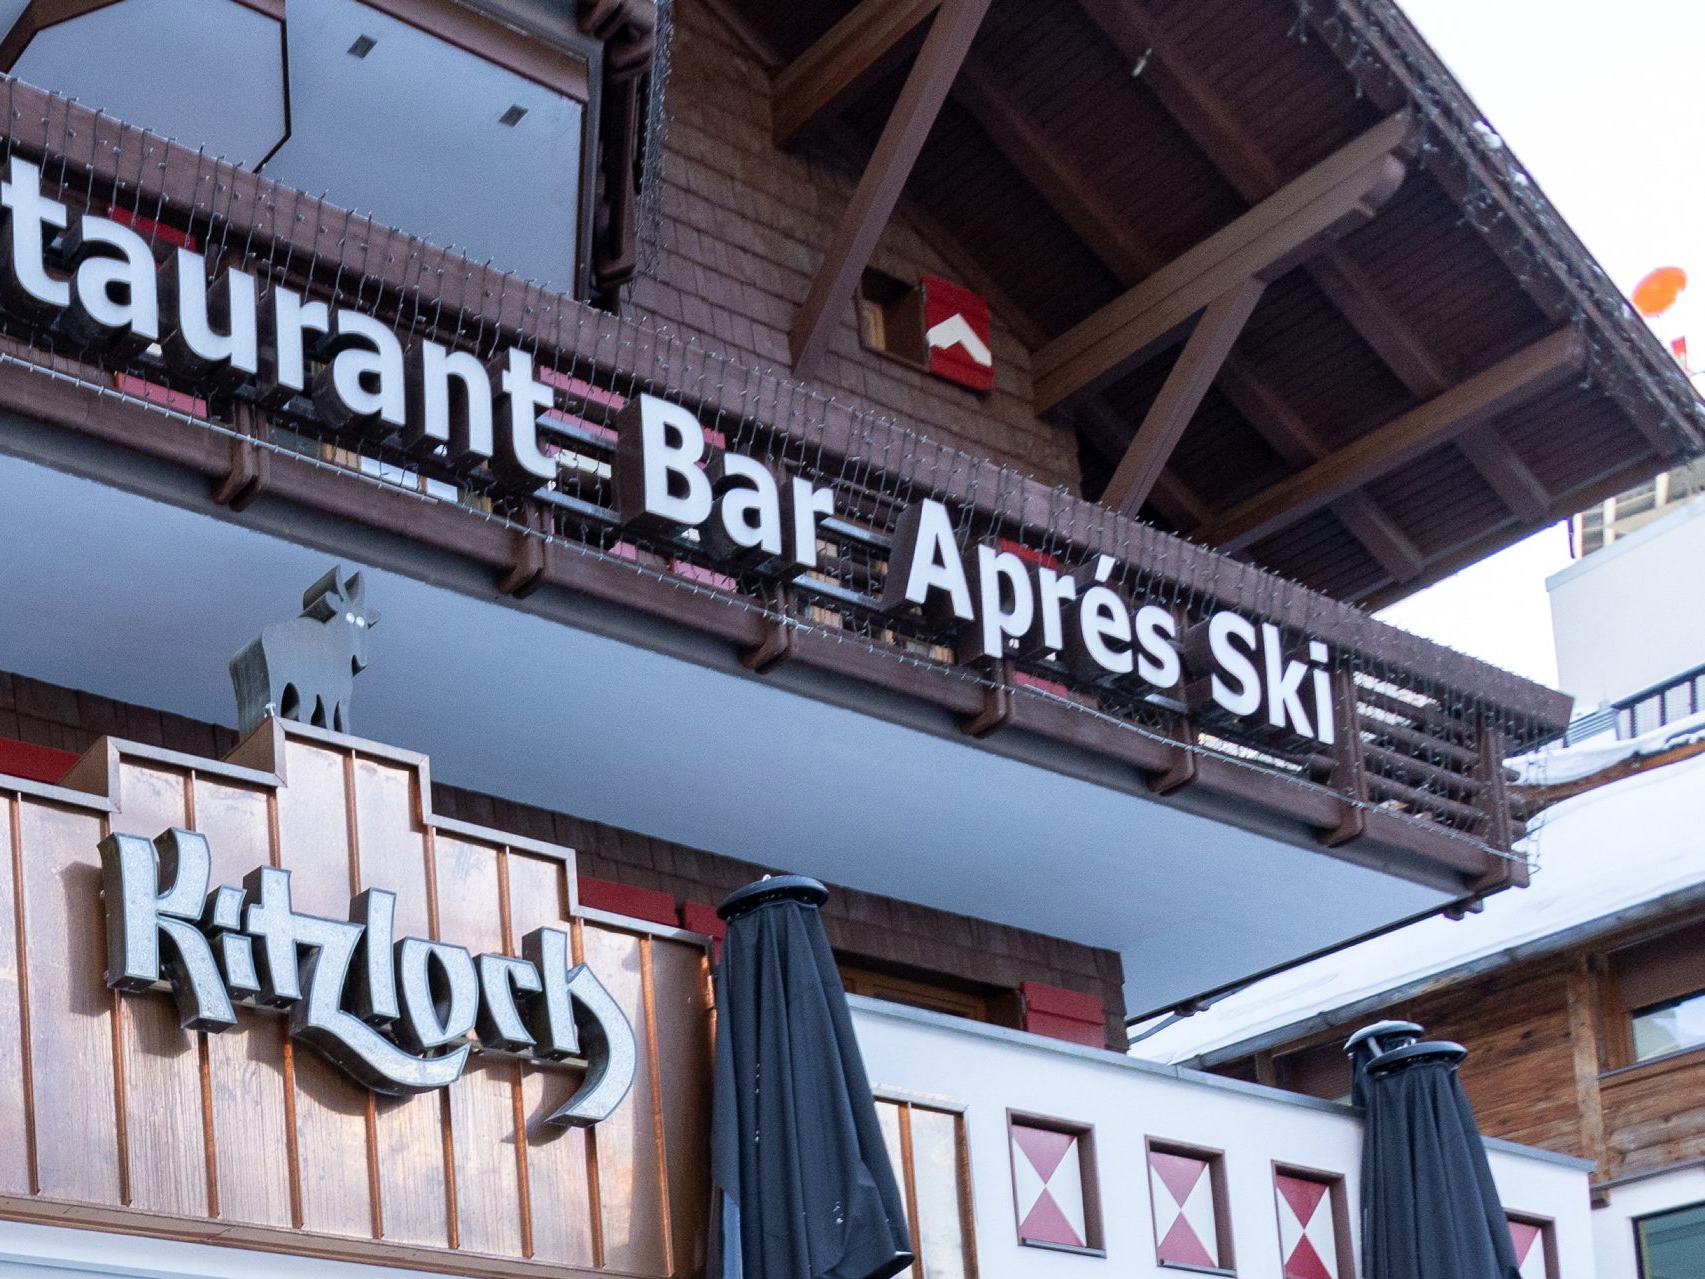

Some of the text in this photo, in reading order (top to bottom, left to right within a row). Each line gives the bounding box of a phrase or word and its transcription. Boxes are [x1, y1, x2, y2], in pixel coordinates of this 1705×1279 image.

[639, 391, 835, 570] Bar
[904, 497, 1183, 690] Aprés
[1207, 611, 1336, 746] Ski
[98, 827, 637, 1127] Kitzloch
